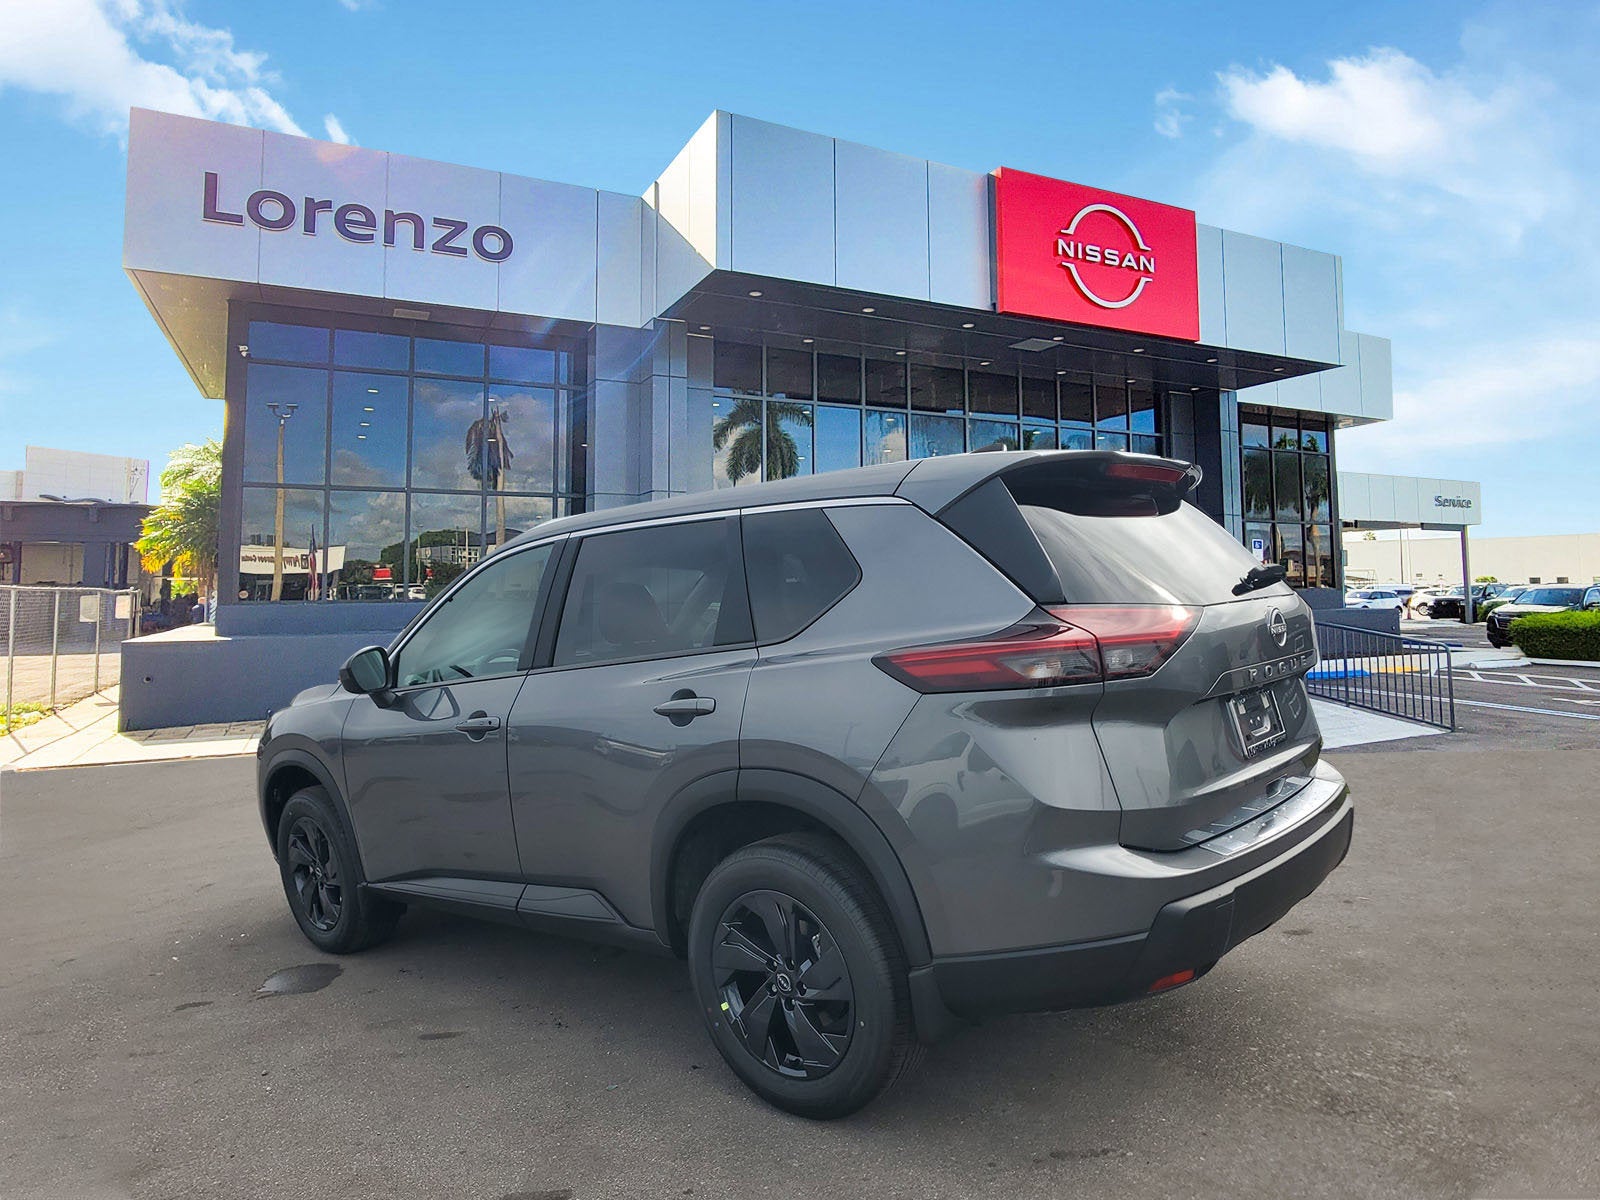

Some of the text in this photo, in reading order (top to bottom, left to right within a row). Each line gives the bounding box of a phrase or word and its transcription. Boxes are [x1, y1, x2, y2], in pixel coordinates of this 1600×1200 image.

[202, 171, 515, 263] Lorenzo
[1057, 238, 1155, 273] NISSAN
[1434, 495, 1472, 509] Service
